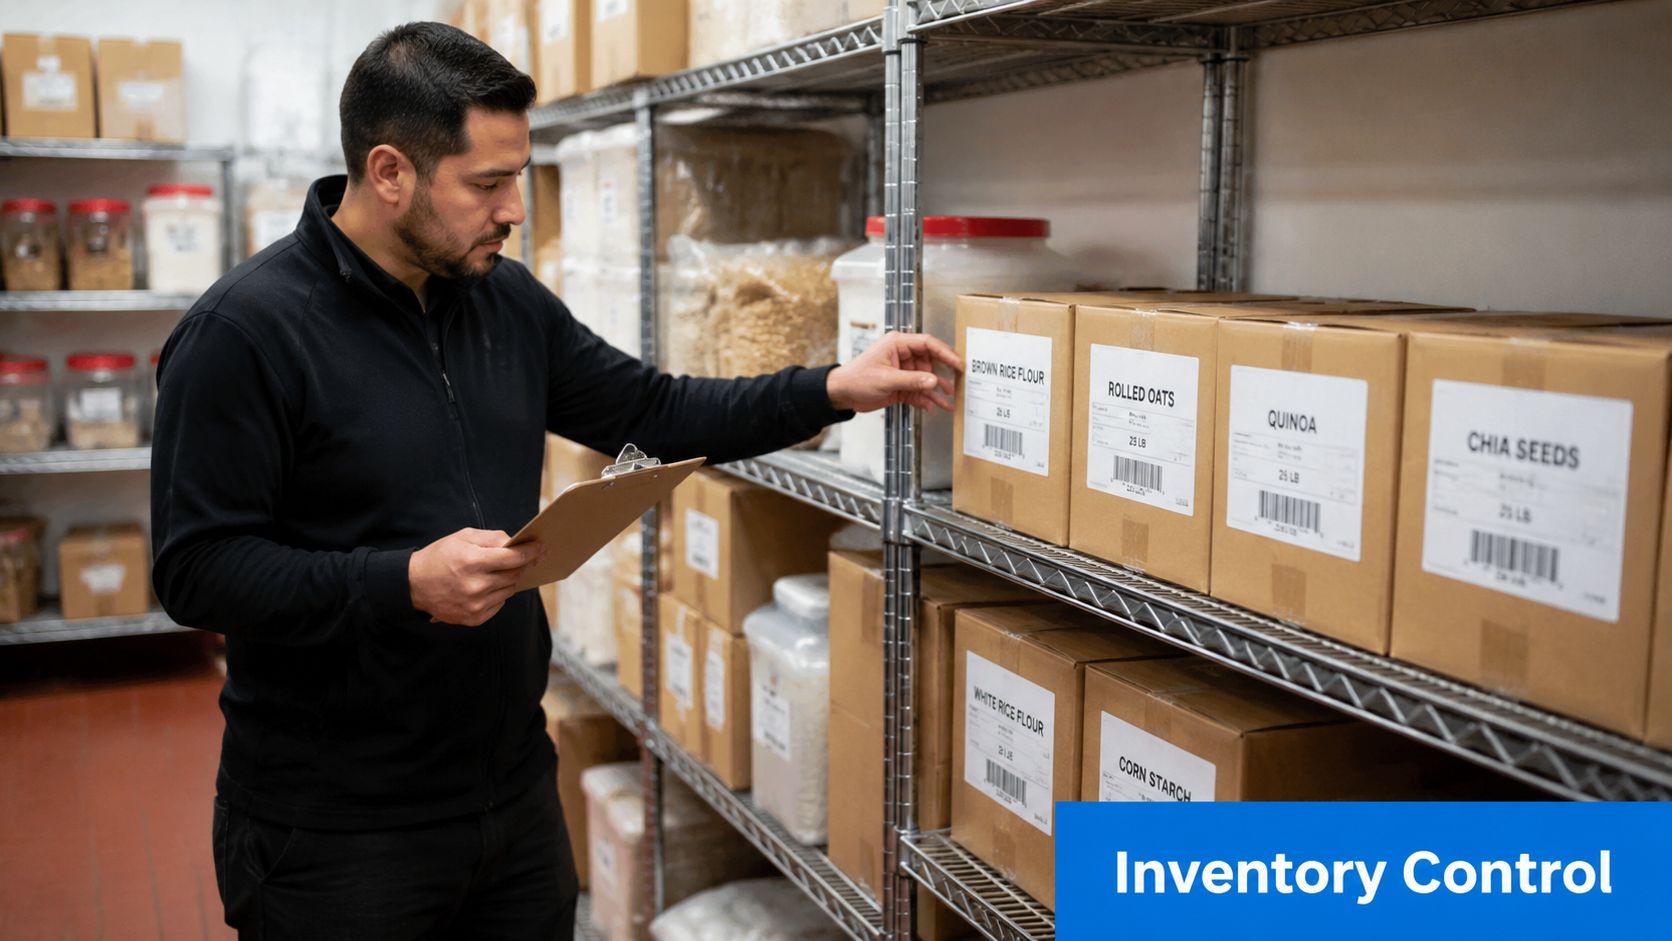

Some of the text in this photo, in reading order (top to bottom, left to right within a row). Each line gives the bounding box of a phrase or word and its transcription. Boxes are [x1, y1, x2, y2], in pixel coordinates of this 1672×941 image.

[972, 359, 1045, 386] BROWN RICE FLOUR
[1108, 381, 1175, 408] ROLLED OATS
[1268, 409, 1318, 434] QUINOA
[1138, 437, 1147, 449] LB
[1467, 430, 1580, 470] CHIA SEEDS
[1290, 470, 1300, 484] LB
[1516, 506, 1532, 524] LB
[974, 686, 997, 711] WHITE
[998, 699, 1015, 721] RICE
[1016, 709, 1045, 737] FLOUR
[1119, 756, 1147, 783] CORN
[1149, 771, 1192, 802] STARCH
